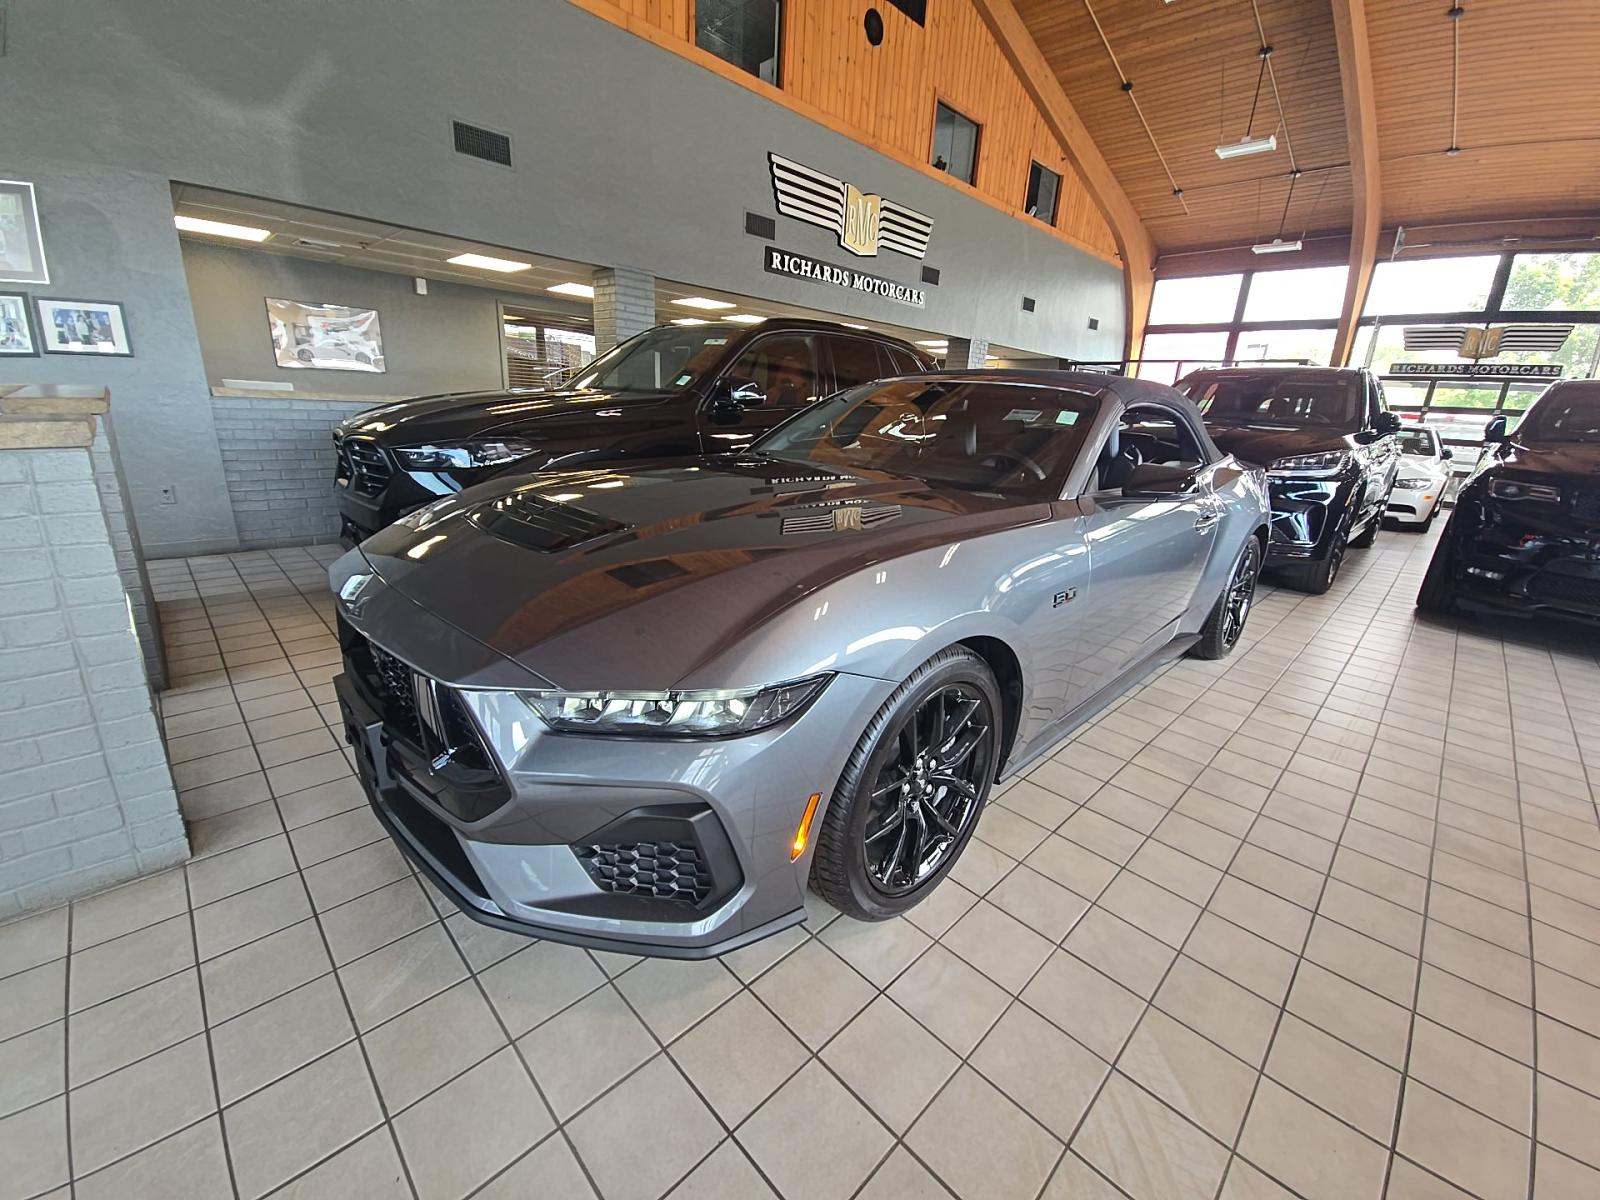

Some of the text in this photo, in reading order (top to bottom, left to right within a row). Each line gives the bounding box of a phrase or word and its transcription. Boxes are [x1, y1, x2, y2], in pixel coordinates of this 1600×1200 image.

[847, 199, 878, 246] RMC
[772, 253, 926, 304] RICHARDS MOTORCARS
[1390, 365, 1561, 376] RICHARDS MOTORCARS
